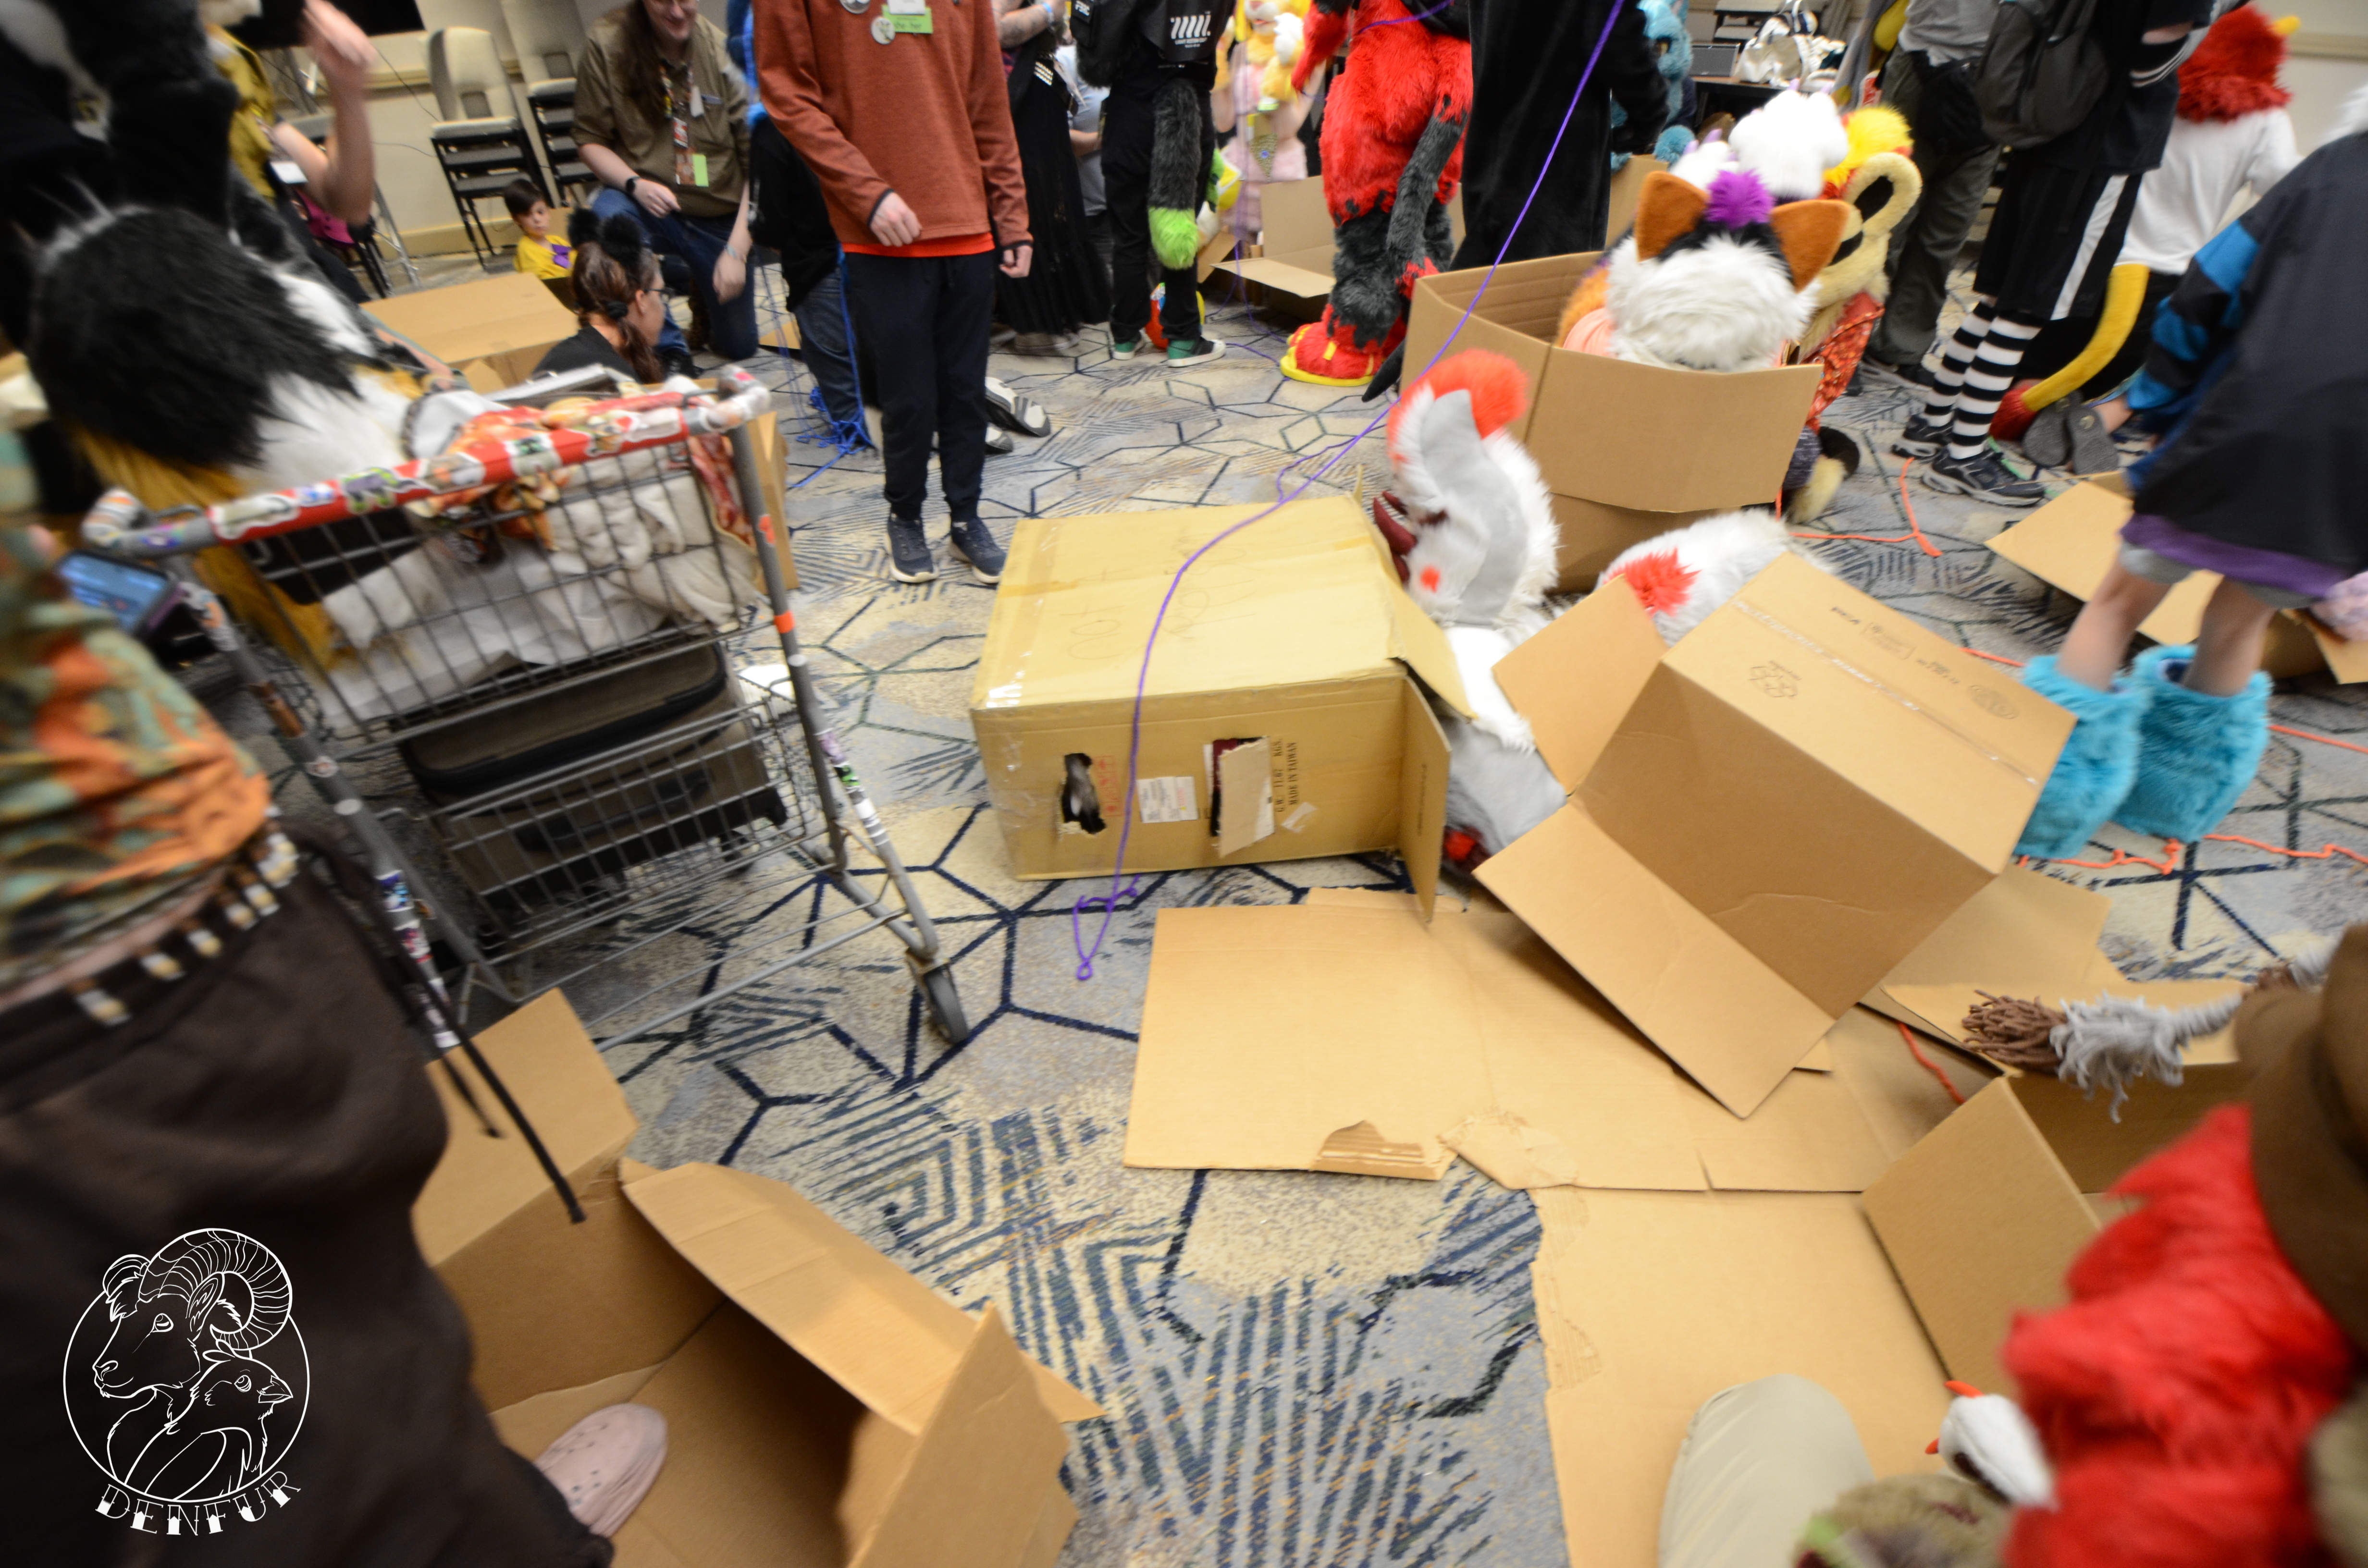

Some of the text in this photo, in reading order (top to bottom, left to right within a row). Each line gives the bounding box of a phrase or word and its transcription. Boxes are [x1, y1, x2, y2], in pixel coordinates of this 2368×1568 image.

[1286, 742, 1298, 806] MADE IN TAIWAN
